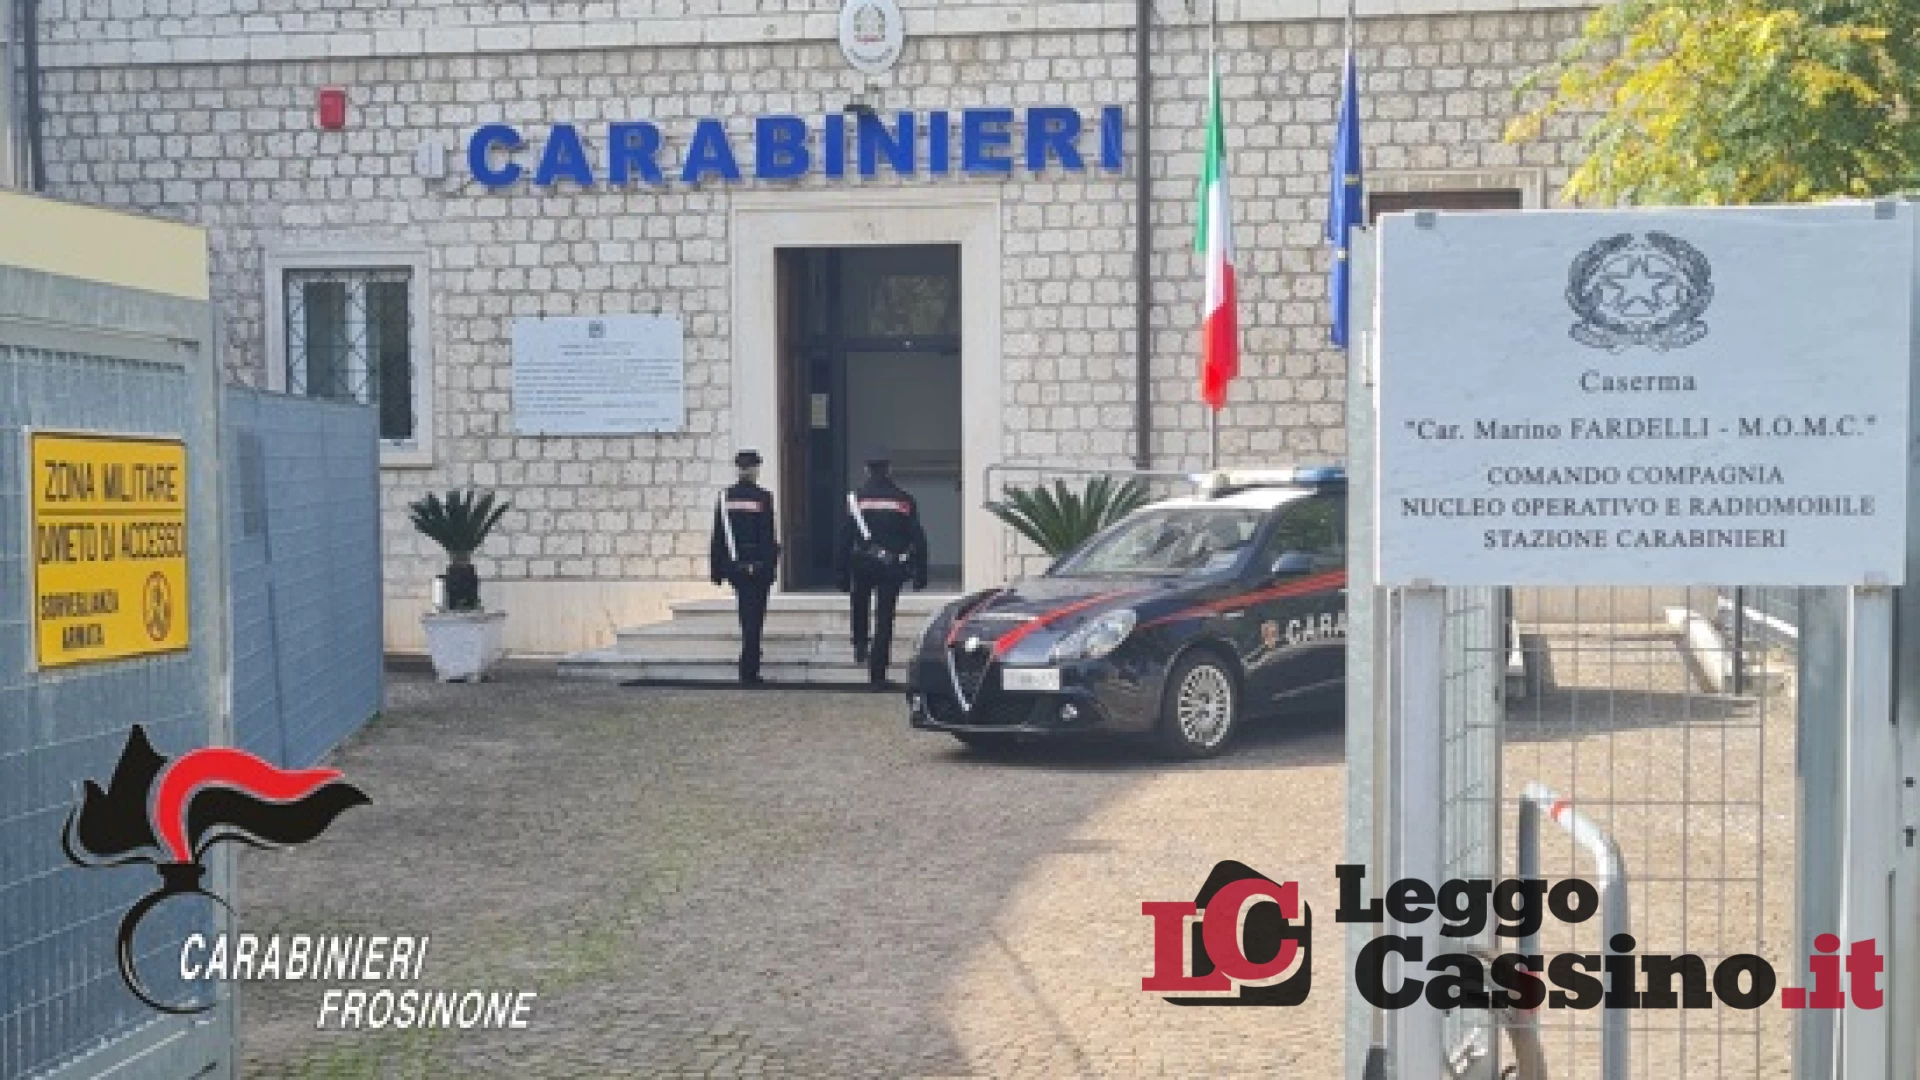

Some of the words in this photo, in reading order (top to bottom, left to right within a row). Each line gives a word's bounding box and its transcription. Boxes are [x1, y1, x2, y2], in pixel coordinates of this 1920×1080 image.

[467, 105, 1123, 187] CARABINIERI
[1580, 369, 1698, 393] Caserma
[1473, 418, 1562, 440] Marino
[1570, 417, 1709, 440] FARDELLI
[45, 460, 95, 502] ZONA
[103, 463, 178, 502] MILITARE
[1487, 466, 1621, 485] COMANDO
[1627, 465, 1785, 485] COMPAGNIA
[1400, 497, 1506, 517] NUCLEO
[1511, 497, 1658, 516] OPERATIVO
[1665, 497, 1681, 516] E
[1689, 496, 1876, 516] RADIOMOBILE
[1483, 529, 1608, 549] STAZIONE
[1615, 529, 1786, 548] CARABINIERI
